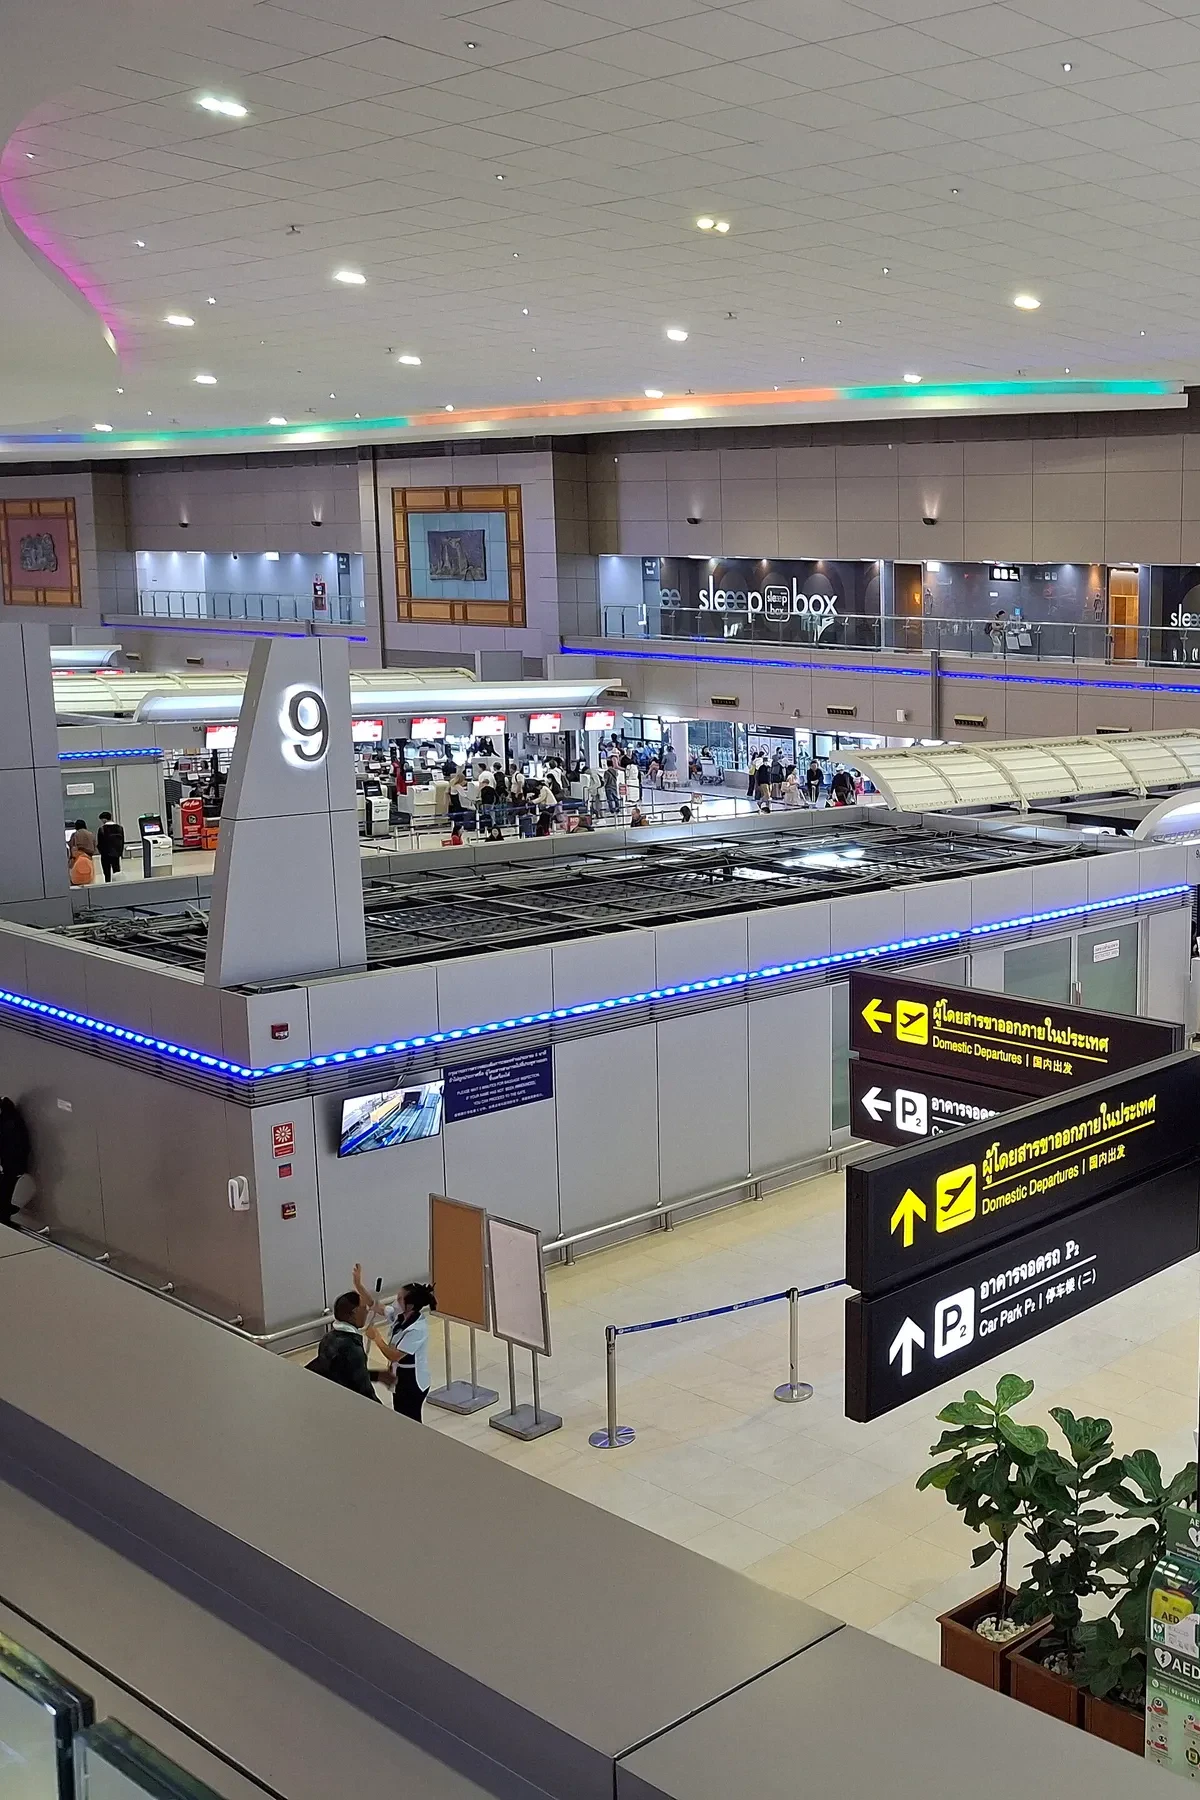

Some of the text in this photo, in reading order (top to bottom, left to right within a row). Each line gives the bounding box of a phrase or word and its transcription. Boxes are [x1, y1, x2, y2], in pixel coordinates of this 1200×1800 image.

[792, 577, 838, 616] box
[288, 688, 331, 765] 9
[932, 999, 1109, 1053] ผู้โดยสารขาออกภายในประเทศ
[932, 1036, 1073, 1075] Domestic Departures 国内出发
[982, 1094, 1156, 1184] ผู้โดยสารขาออกภายในประเทศ
[982, 1144, 1126, 1215] Domestic Departures 国内出发
[980, 1248, 1060, 1300] อาคารจอดรถ
[980, 1317, 998, 1336] Car
[1000, 1304, 1022, 1328] Park
[1154, 1634, 1165, 1644] AED
[1162, 1612, 1180, 1624] AED
